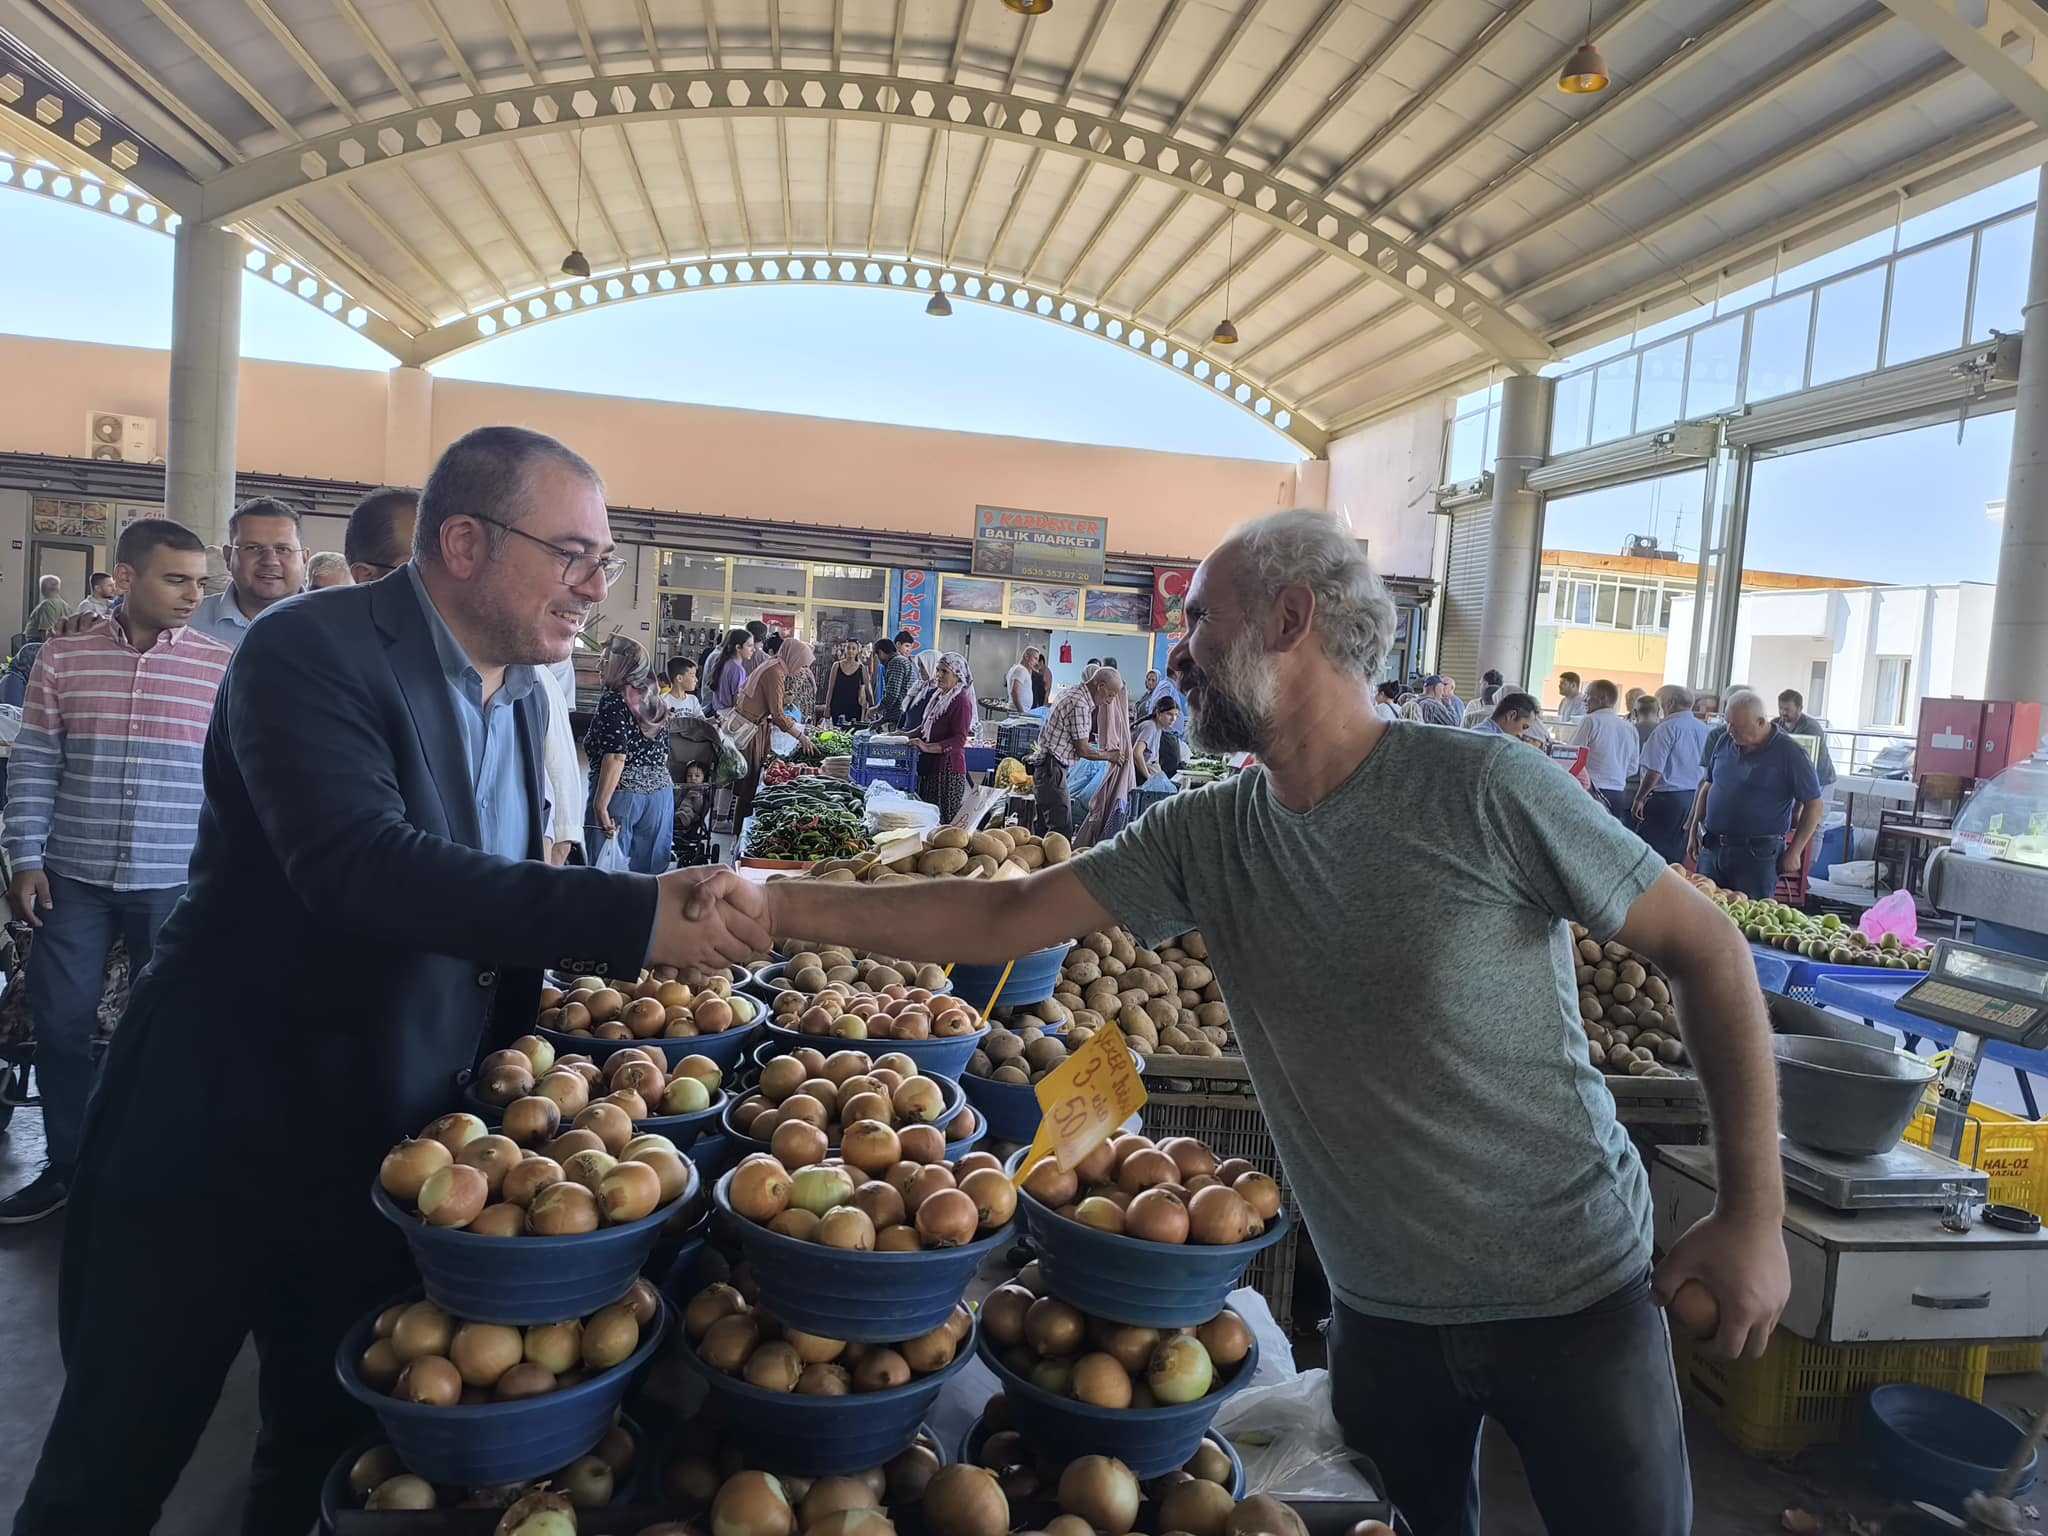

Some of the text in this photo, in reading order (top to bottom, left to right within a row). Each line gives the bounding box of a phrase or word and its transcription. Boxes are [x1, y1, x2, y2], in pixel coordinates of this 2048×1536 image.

[985, 529, 1095, 547] BALIK MARKET
[903, 569, 926, 590] 9
[1053, 1096, 1088, 1138] 50
[1983, 1158, 2030, 1170] HAL-01
